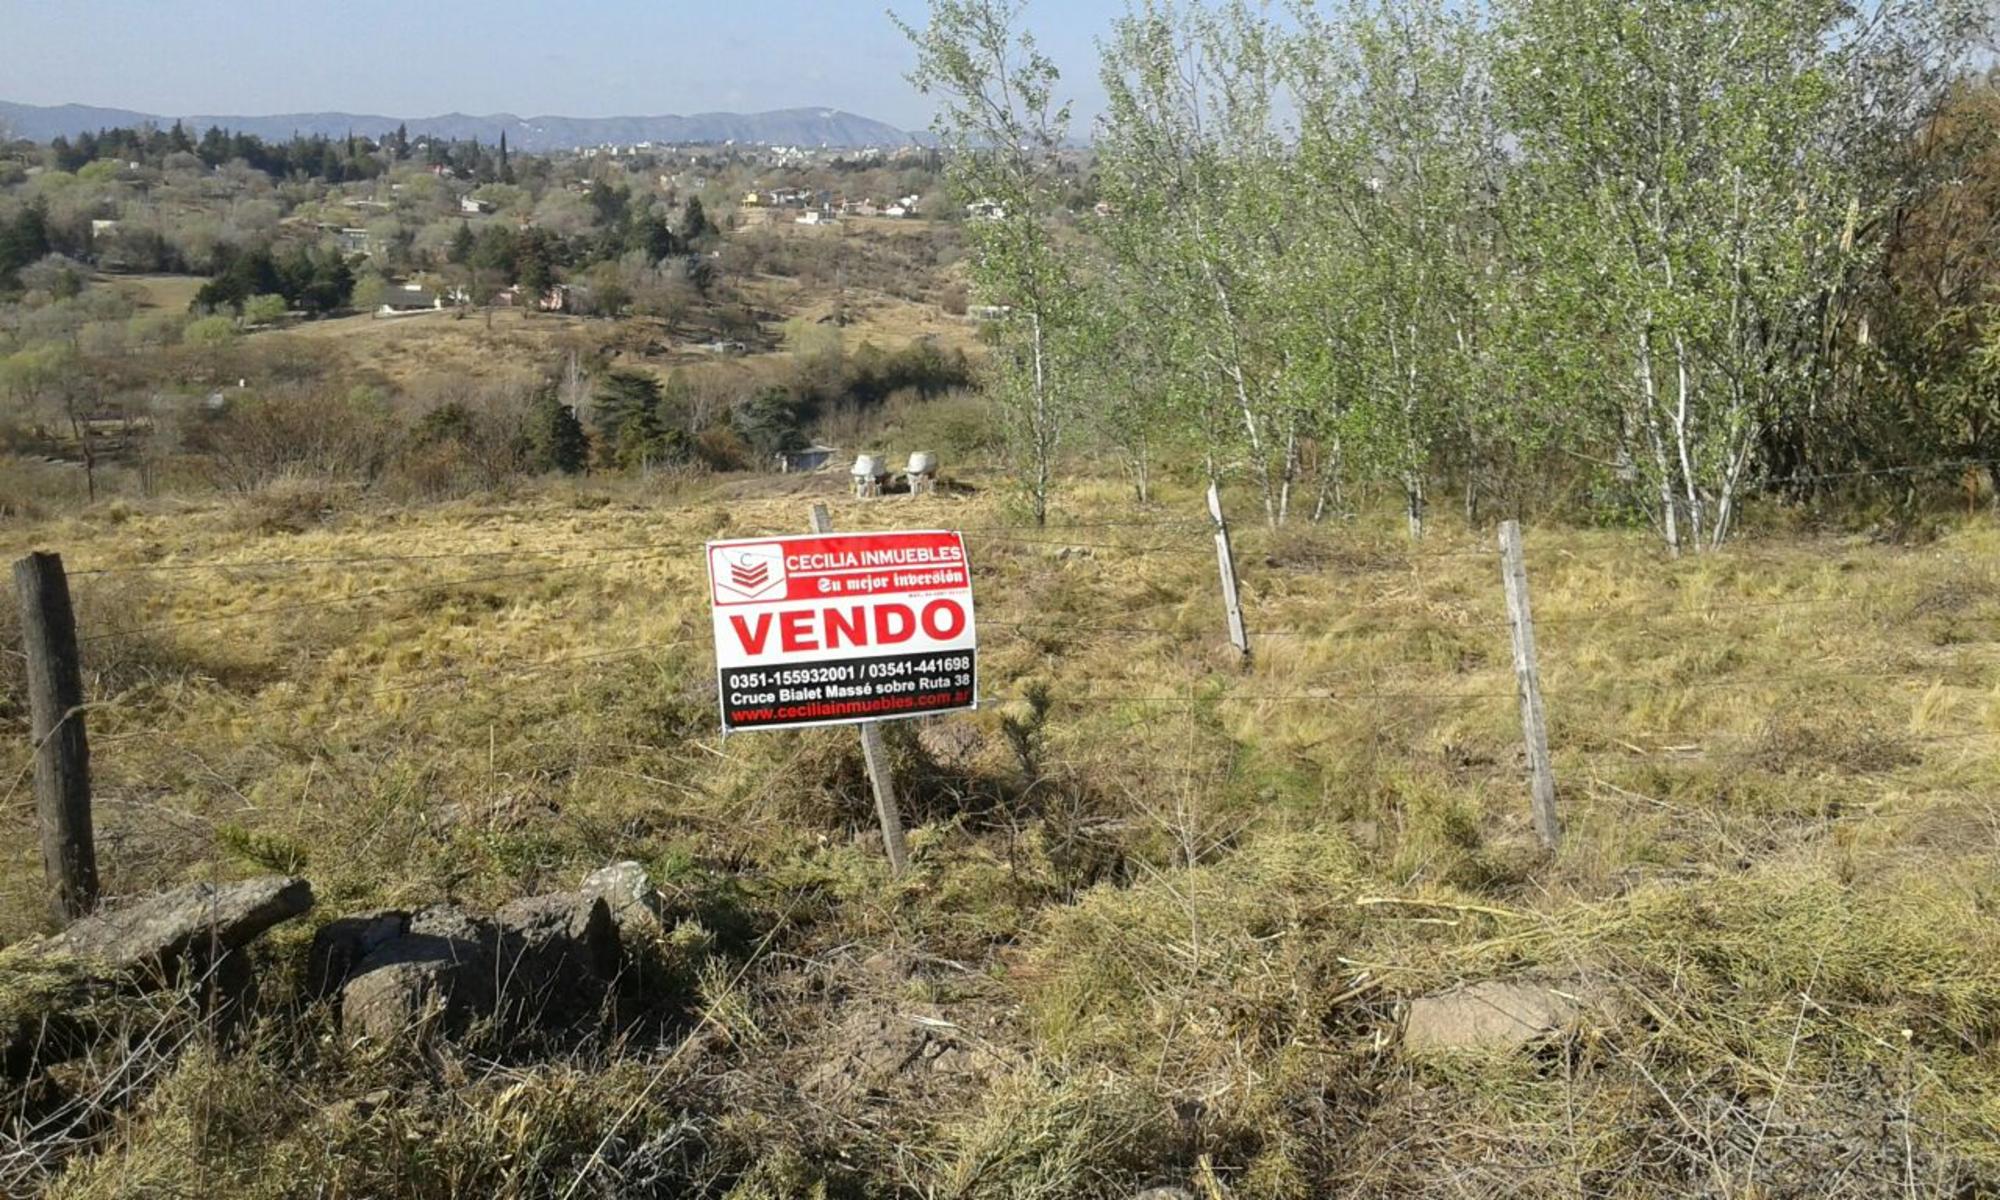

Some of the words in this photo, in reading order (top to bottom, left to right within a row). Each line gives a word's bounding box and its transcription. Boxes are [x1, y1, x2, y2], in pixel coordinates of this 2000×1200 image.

[786, 553, 859, 571] CECILIA
[861, 546, 962, 566] INMUEBLES
[847, 575, 889, 592] mejor
[894, 570, 963, 587] inversión
[729, 598, 966, 656] VENDO
[729, 667, 855, 689] 0351-155932001
[869, 656, 970, 678] 03541-441698
[730, 692, 775, 706] Cruce
[779, 688, 822, 702] Bialet
[825, 682, 872, 698] Massé
[876, 679, 916, 694] sobre
[919, 676, 950, 690] Ruta
[955, 673, 970, 687] 38
[731, 690, 970, 721] www.ceciliainmuebles.com.ar
